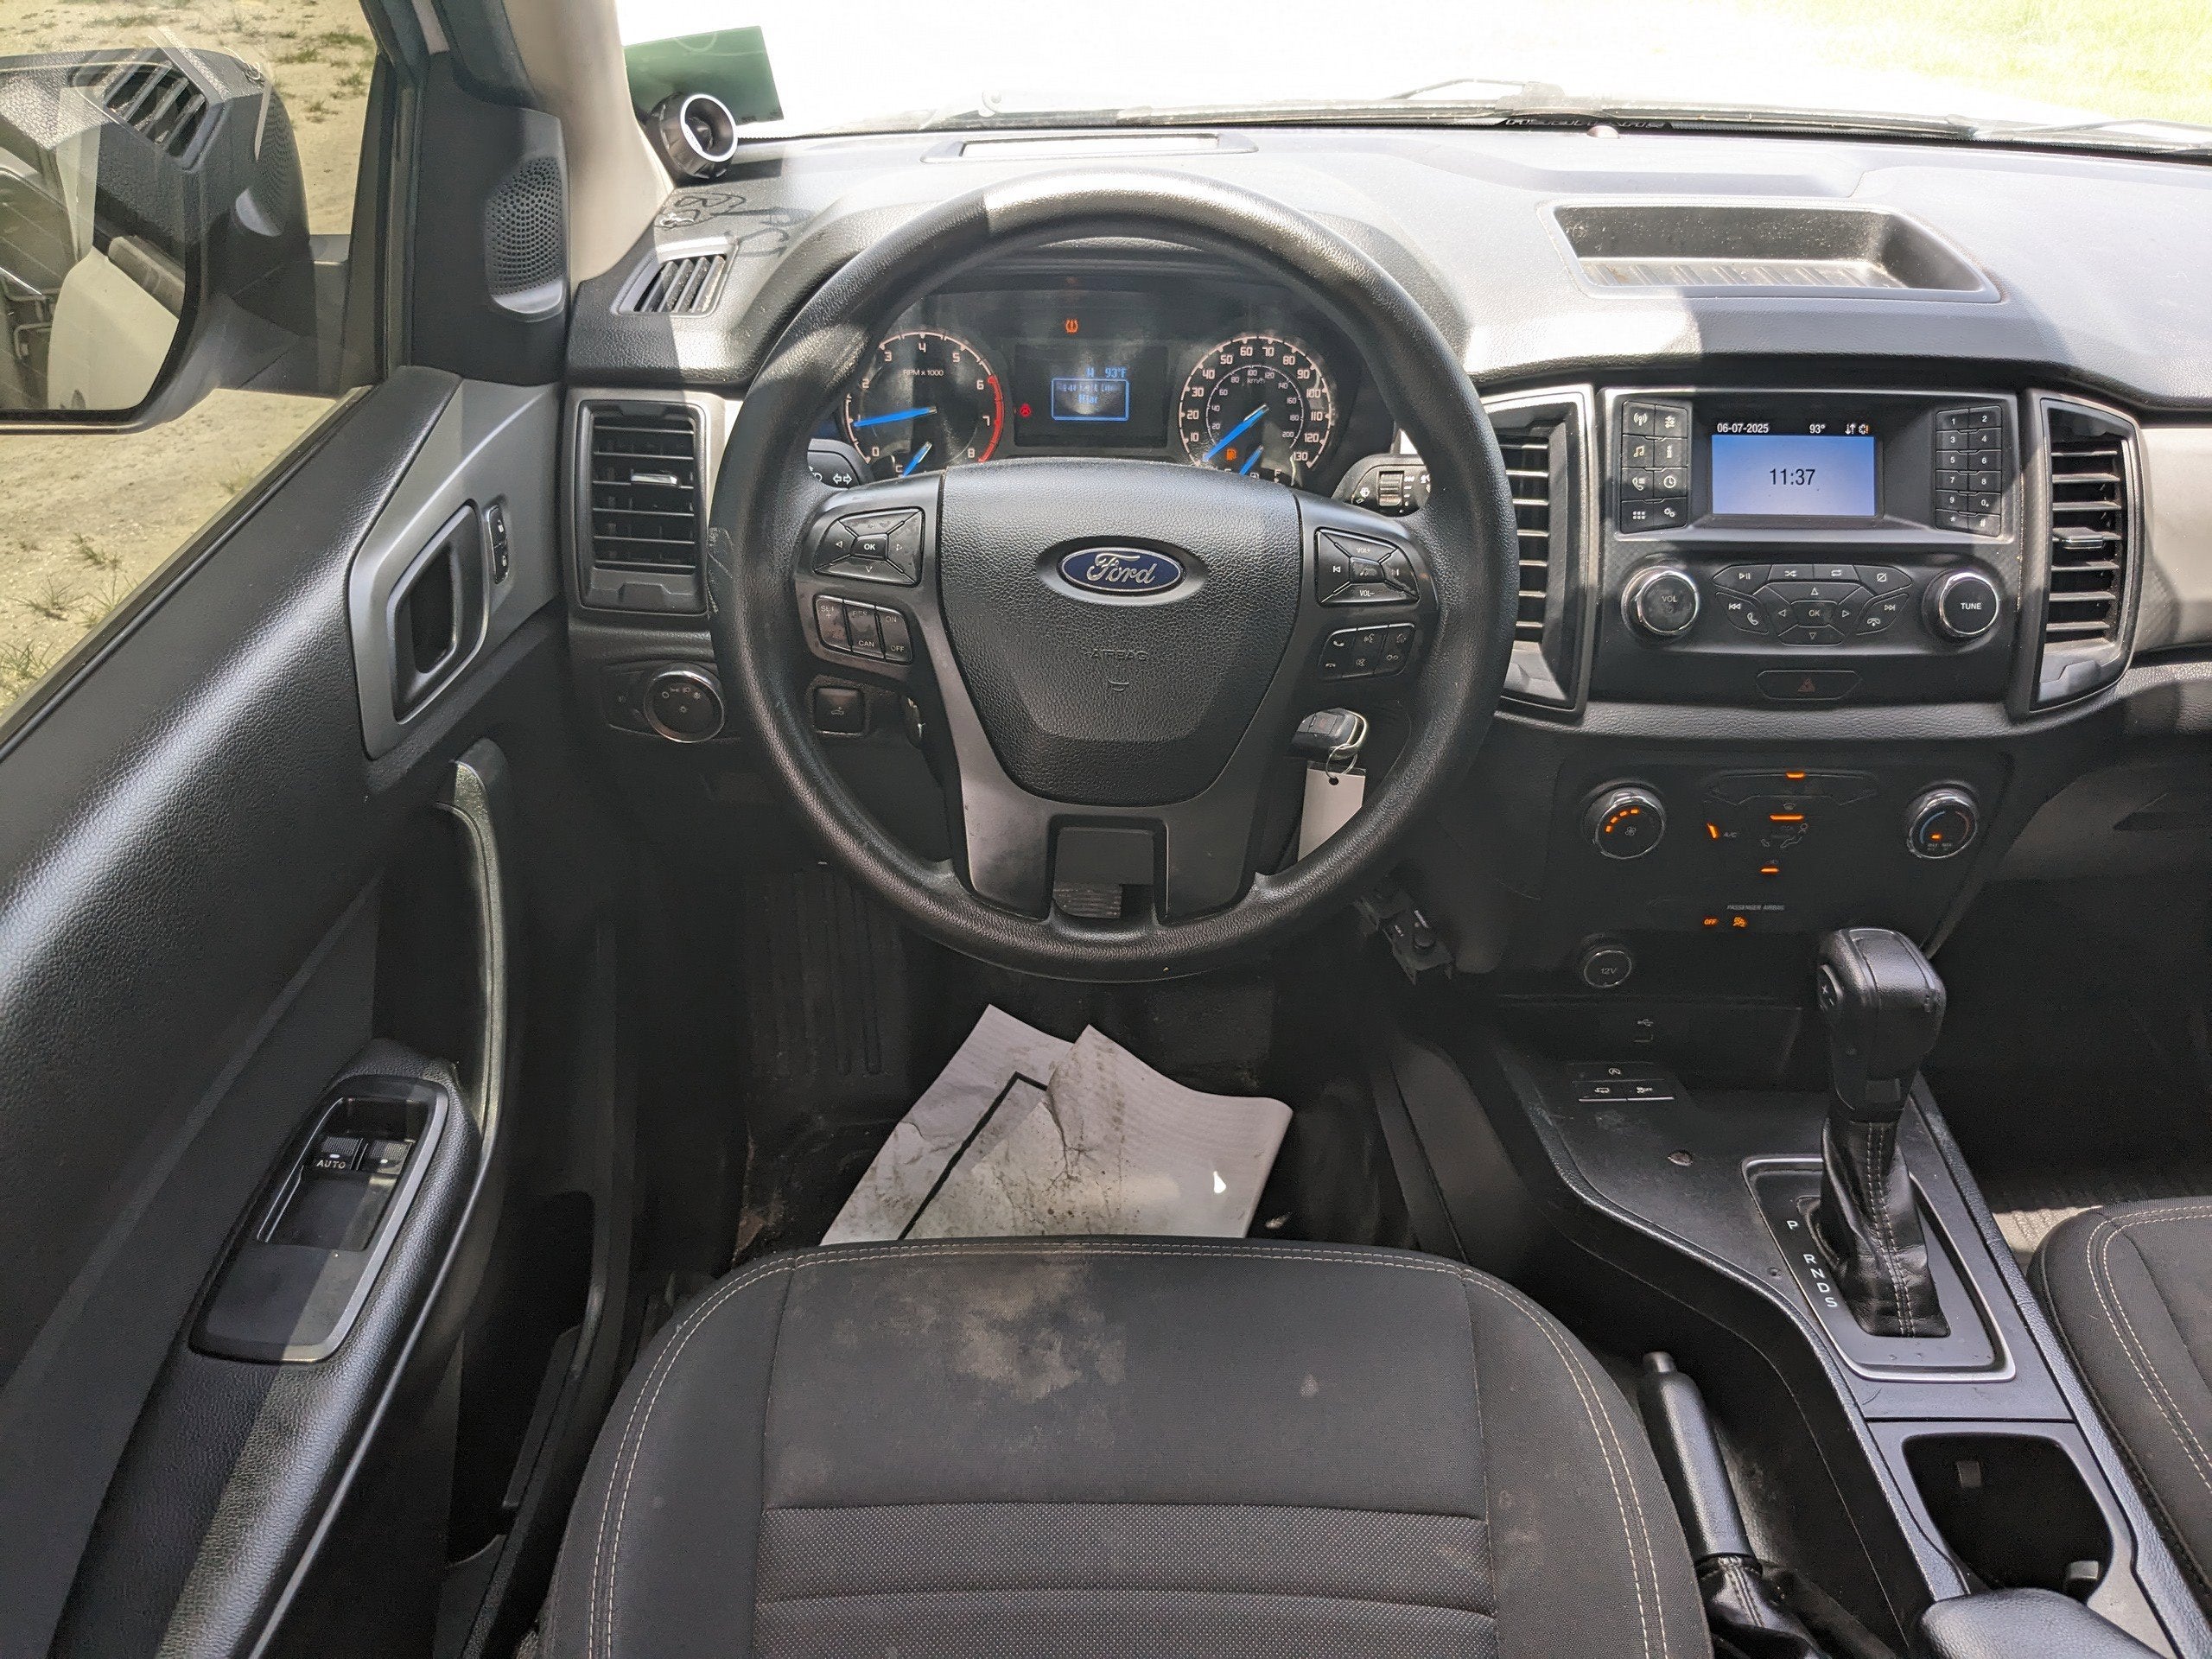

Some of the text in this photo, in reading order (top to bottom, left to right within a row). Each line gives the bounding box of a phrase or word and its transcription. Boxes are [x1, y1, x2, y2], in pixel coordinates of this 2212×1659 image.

[918, 342, 926, 353] 4
[1240, 346, 1253, 356] 60
[1262, 346, 1274, 357] 70
[884, 351, 893, 362] 3
[952, 352, 961, 363] 5
[1220, 354, 1233, 365] 50
[1282, 355, 1295, 365] 80
[1202, 369, 1216, 379] 40
[1297, 369, 1310, 379] 90
[861, 378, 870, 389] 2
[976, 379, 984, 390] 6
[1192, 387, 1204, 397] 30
[1306, 389, 1321, 398] 100
[1186, 410, 1199, 420] 20
[1311, 411, 1323, 421] 110
[982, 415, 990, 426] 7
[1717, 423, 1770, 433] 06-07-2025
[1190, 432, 1199, 442] 10
[1304, 433, 1319, 442] 120
[967, 448, 976, 458] 8
[1293, 451, 1308, 461] 130
[1770, 468, 1815, 486] 11:37
[1086, 553, 1158, 584] Ford
[316, 1159, 346, 1169] AUTO
[1787, 1220, 1798, 1230] P
[1803, 1254, 1816, 1264] R
[1810, 1268, 1825, 1279] N
[1817, 1282, 1830, 1293] D
[1825, 1297, 1838, 1307] S
